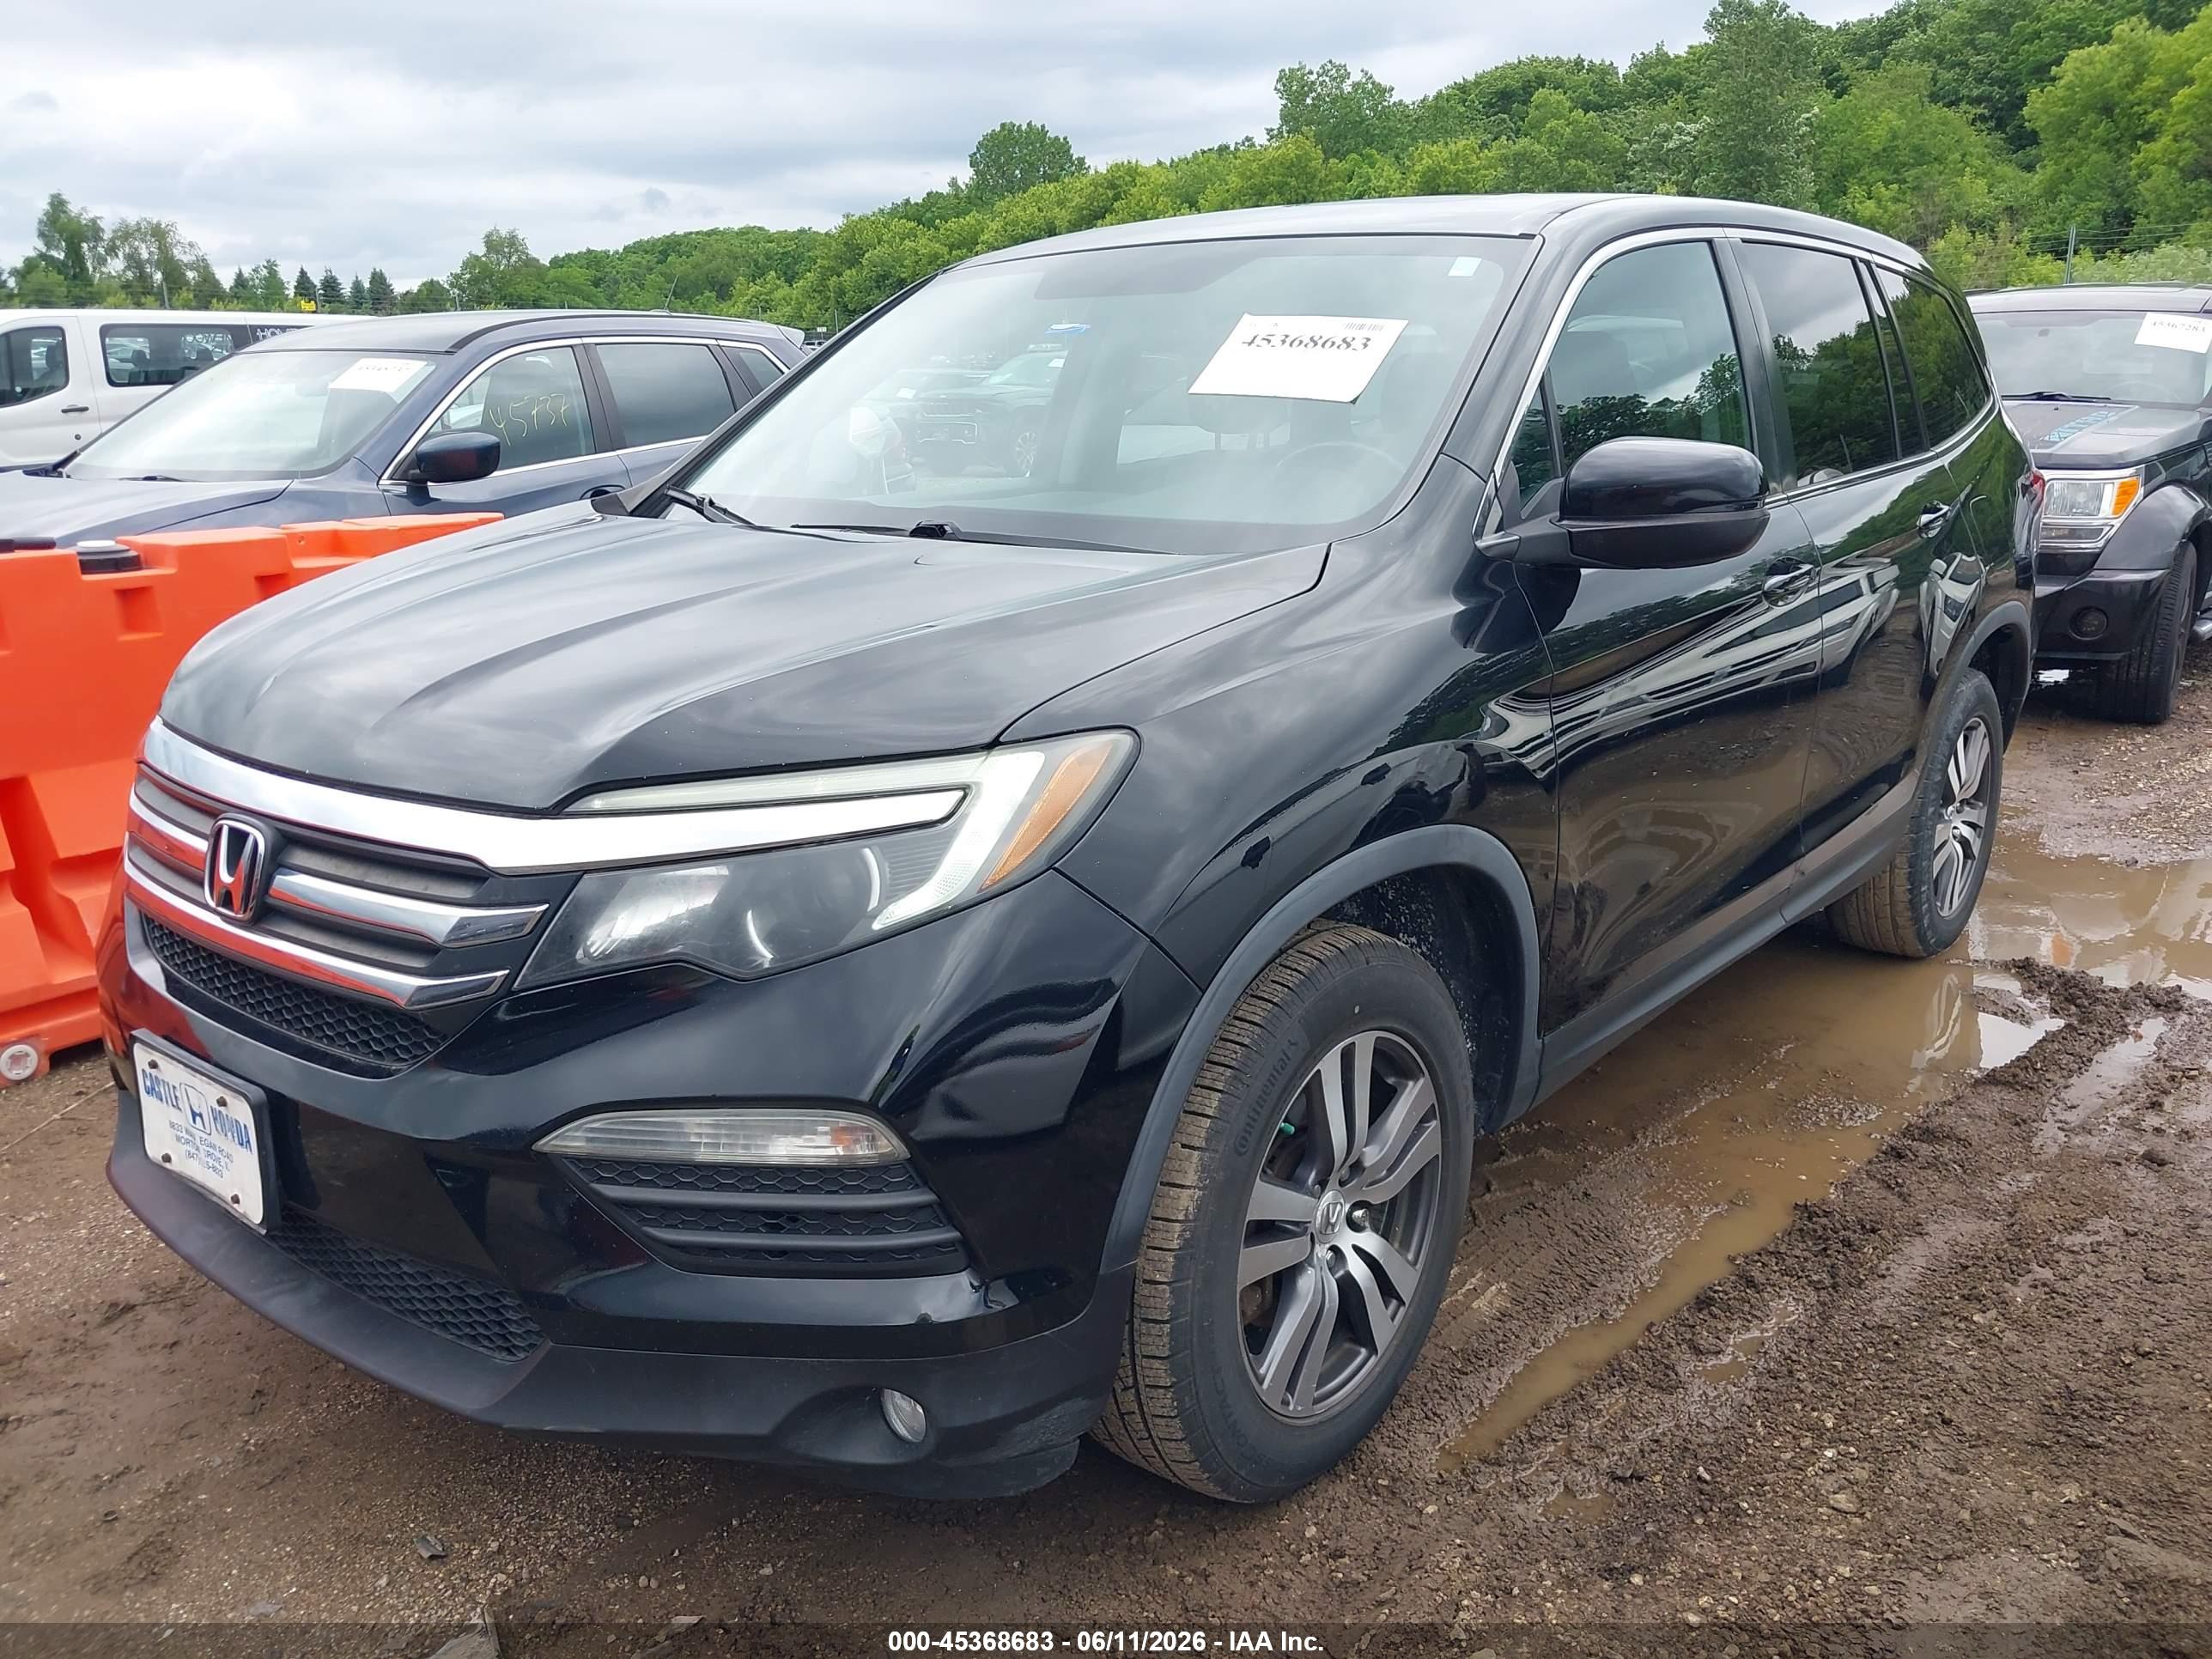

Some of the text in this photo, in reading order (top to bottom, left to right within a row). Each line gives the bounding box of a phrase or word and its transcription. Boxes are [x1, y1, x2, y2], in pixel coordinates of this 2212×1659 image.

[1242, 333, 1371, 351] 45368683
[489, 393, 570, 446] 45737
[142, 1068, 183, 1112] CASTLE
[1234, 1047, 1292, 1157] Continental
